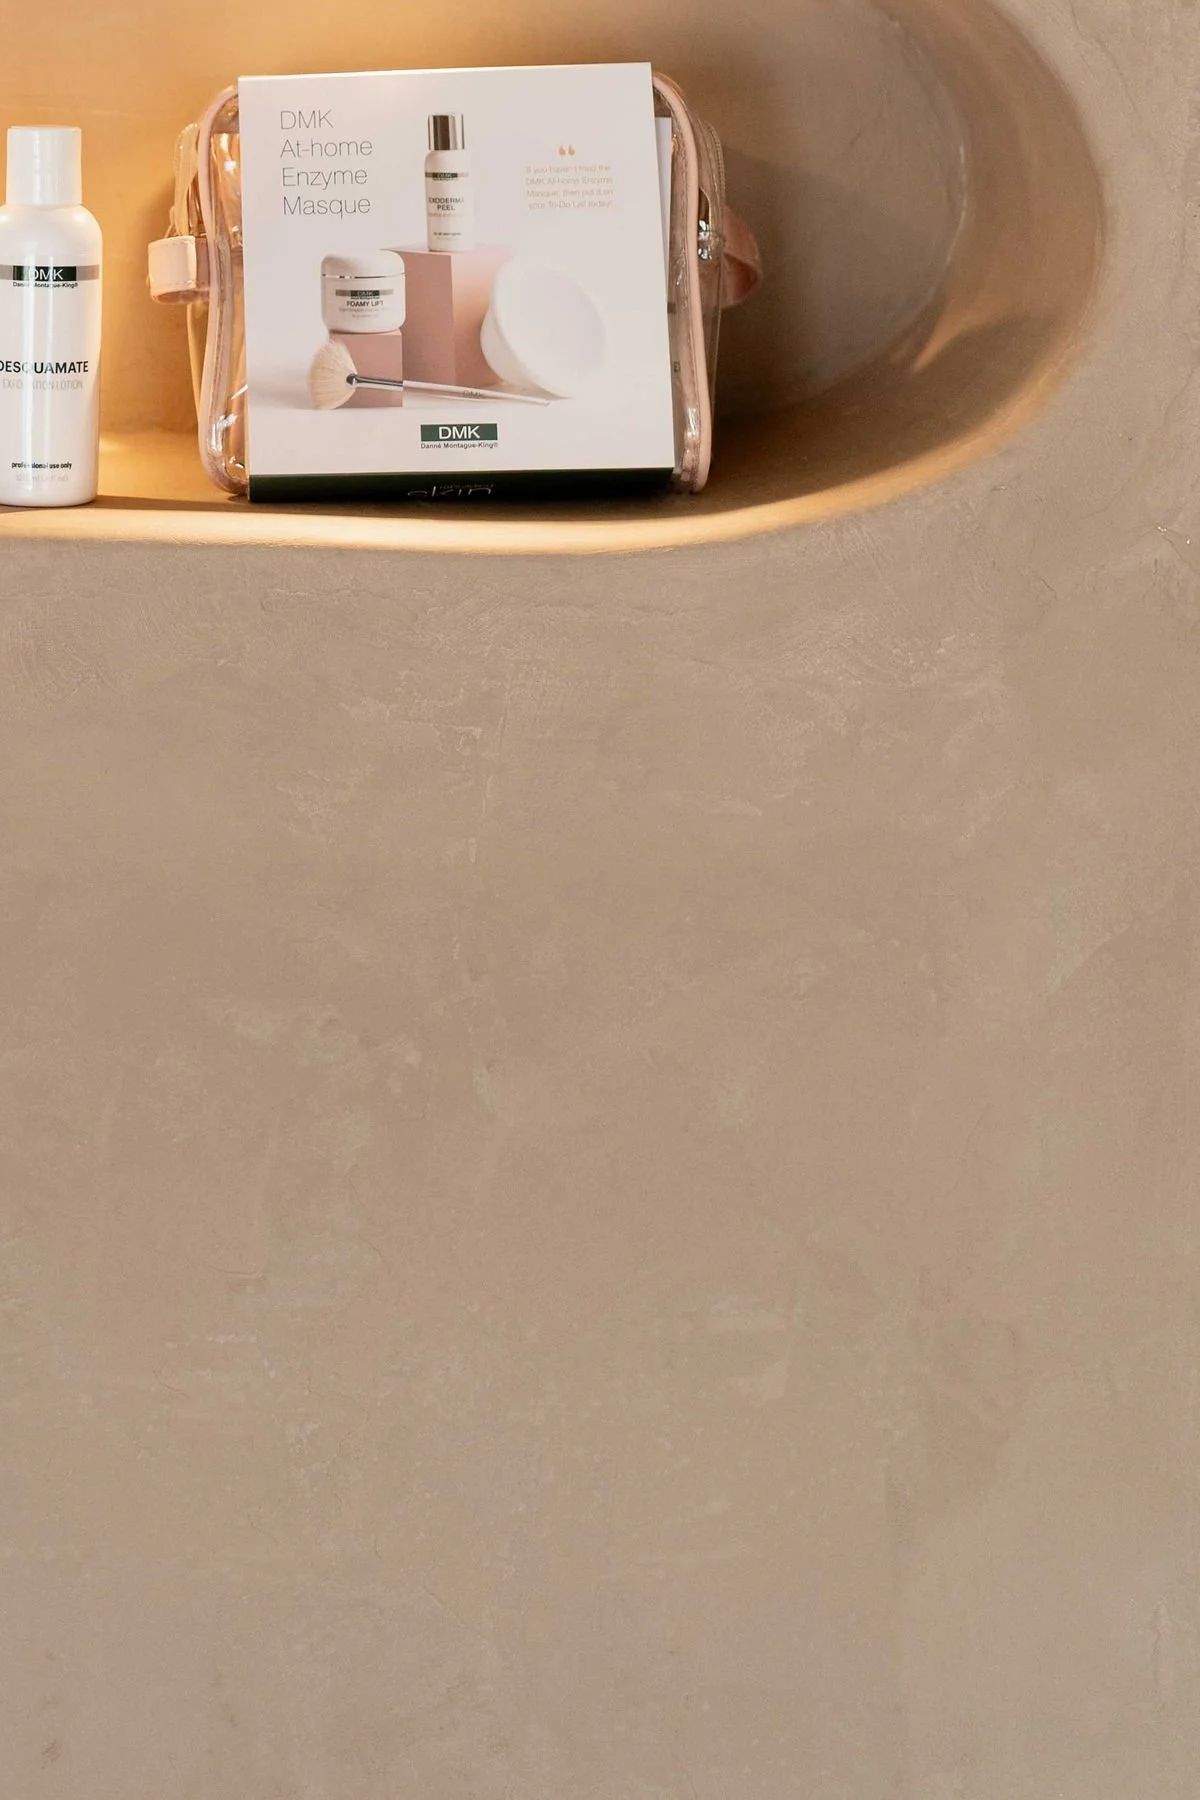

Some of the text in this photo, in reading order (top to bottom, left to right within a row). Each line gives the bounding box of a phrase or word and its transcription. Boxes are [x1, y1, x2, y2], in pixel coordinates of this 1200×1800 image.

[280, 108, 334, 130] DMK
[280, 138, 373, 159] At-home
[282, 167, 368, 191] Enzyme
[283, 195, 371, 221] Masque
[28, 268, 64, 280] DMK
[2, 378, 54, 391] EXFOATION
[439, 425, 480, 439] DMK
[60, 461, 73, 470] only
